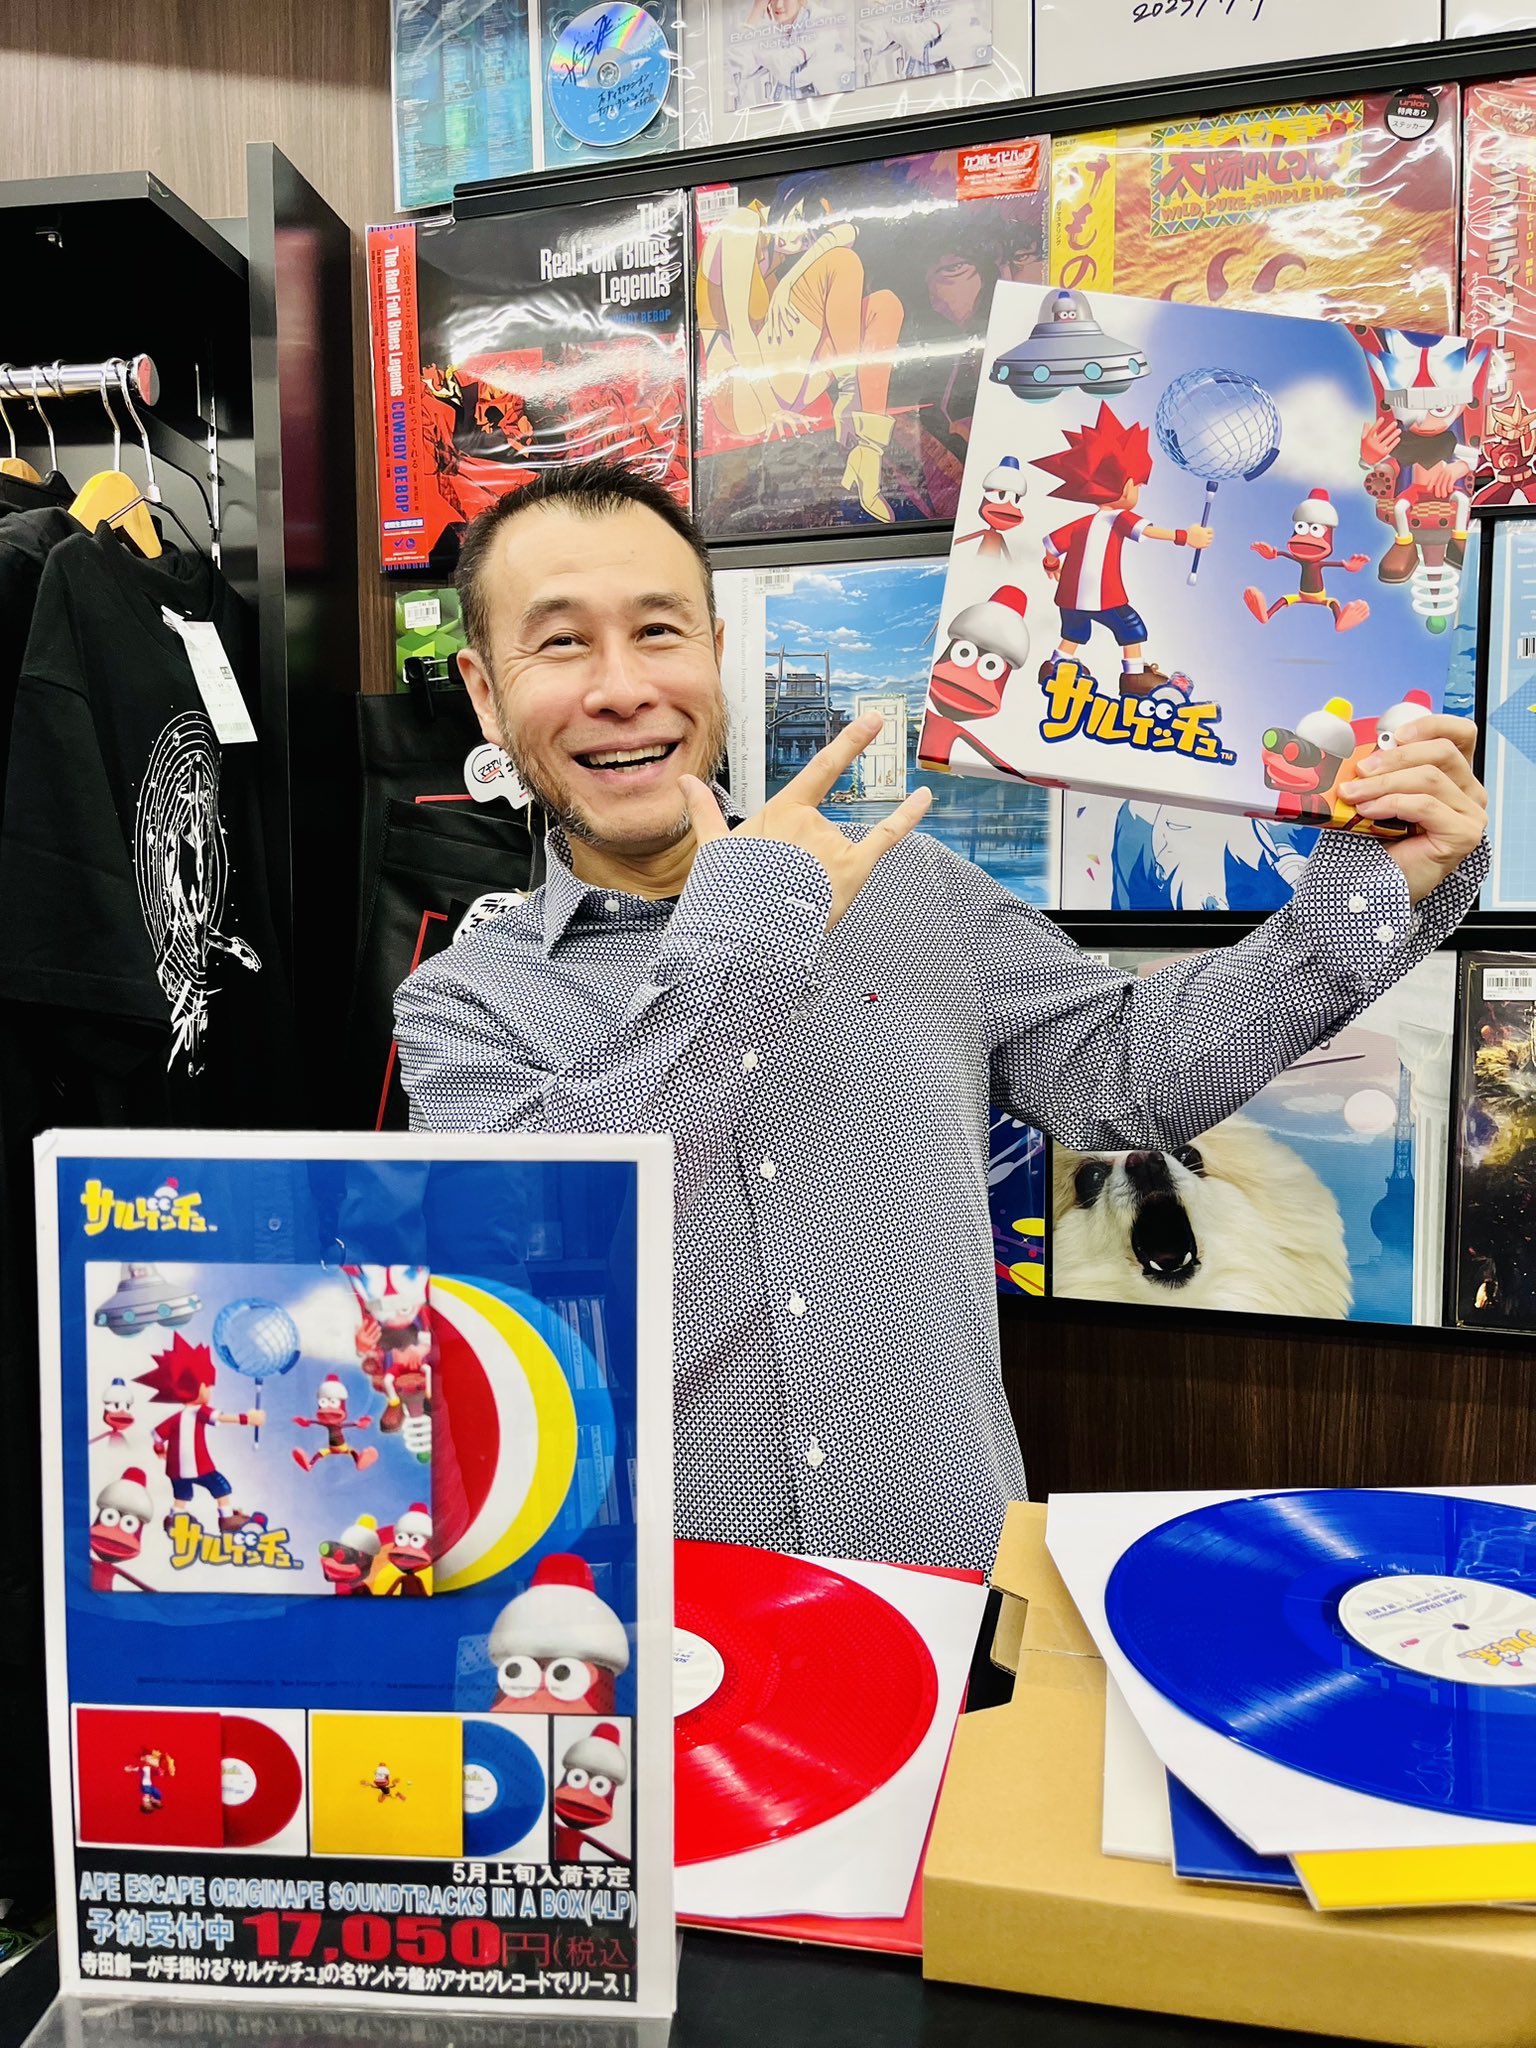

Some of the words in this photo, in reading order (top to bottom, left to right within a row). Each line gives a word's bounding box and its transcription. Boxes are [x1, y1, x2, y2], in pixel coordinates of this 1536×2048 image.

[730, 26, 772, 44] Brand
[773, 21, 803, 35] New
[1397, 106, 1427, 117] 特典あり
[1399, 99, 1430, 109] union
[1392, 120, 1426, 130] ステッカー
[1252, 187, 1311, 207] SIMPLE
[637, 203, 671, 233] The
[384, 245, 400, 268] The
[540, 246, 580, 281] Real
[385, 268, 401, 295] Real
[599, 268, 671, 307] Legends
[386, 295, 402, 319] Folk
[640, 308, 672, 324] BEBOP
[387, 319, 403, 351] Blues
[388, 351, 405, 398] Legends
[391, 401, 407, 461] COWBOY
[393, 465, 410, 513] BEBOP
[1042, 662, 1219, 758] サルゲッチュ
[80, 1178, 208, 1237] サルゲッチュ
[168, 1513, 293, 1571] サルゲッチュ
[452, 1862, 631, 1889] 5月上旬入荷予定
[79, 1871, 121, 1901] APE
[124, 1873, 206, 1907] ESCAPE
[208, 1877, 326, 1911] ORIGINAPE
[328, 1880, 487, 1919] SOUNDTRACKS
[491, 1887, 517, 1918] IN
[519, 1888, 537, 1919] A
[541, 1888, 638, 1928] BOX(4LP)
[85, 1907, 235, 1951] 予約受付中
